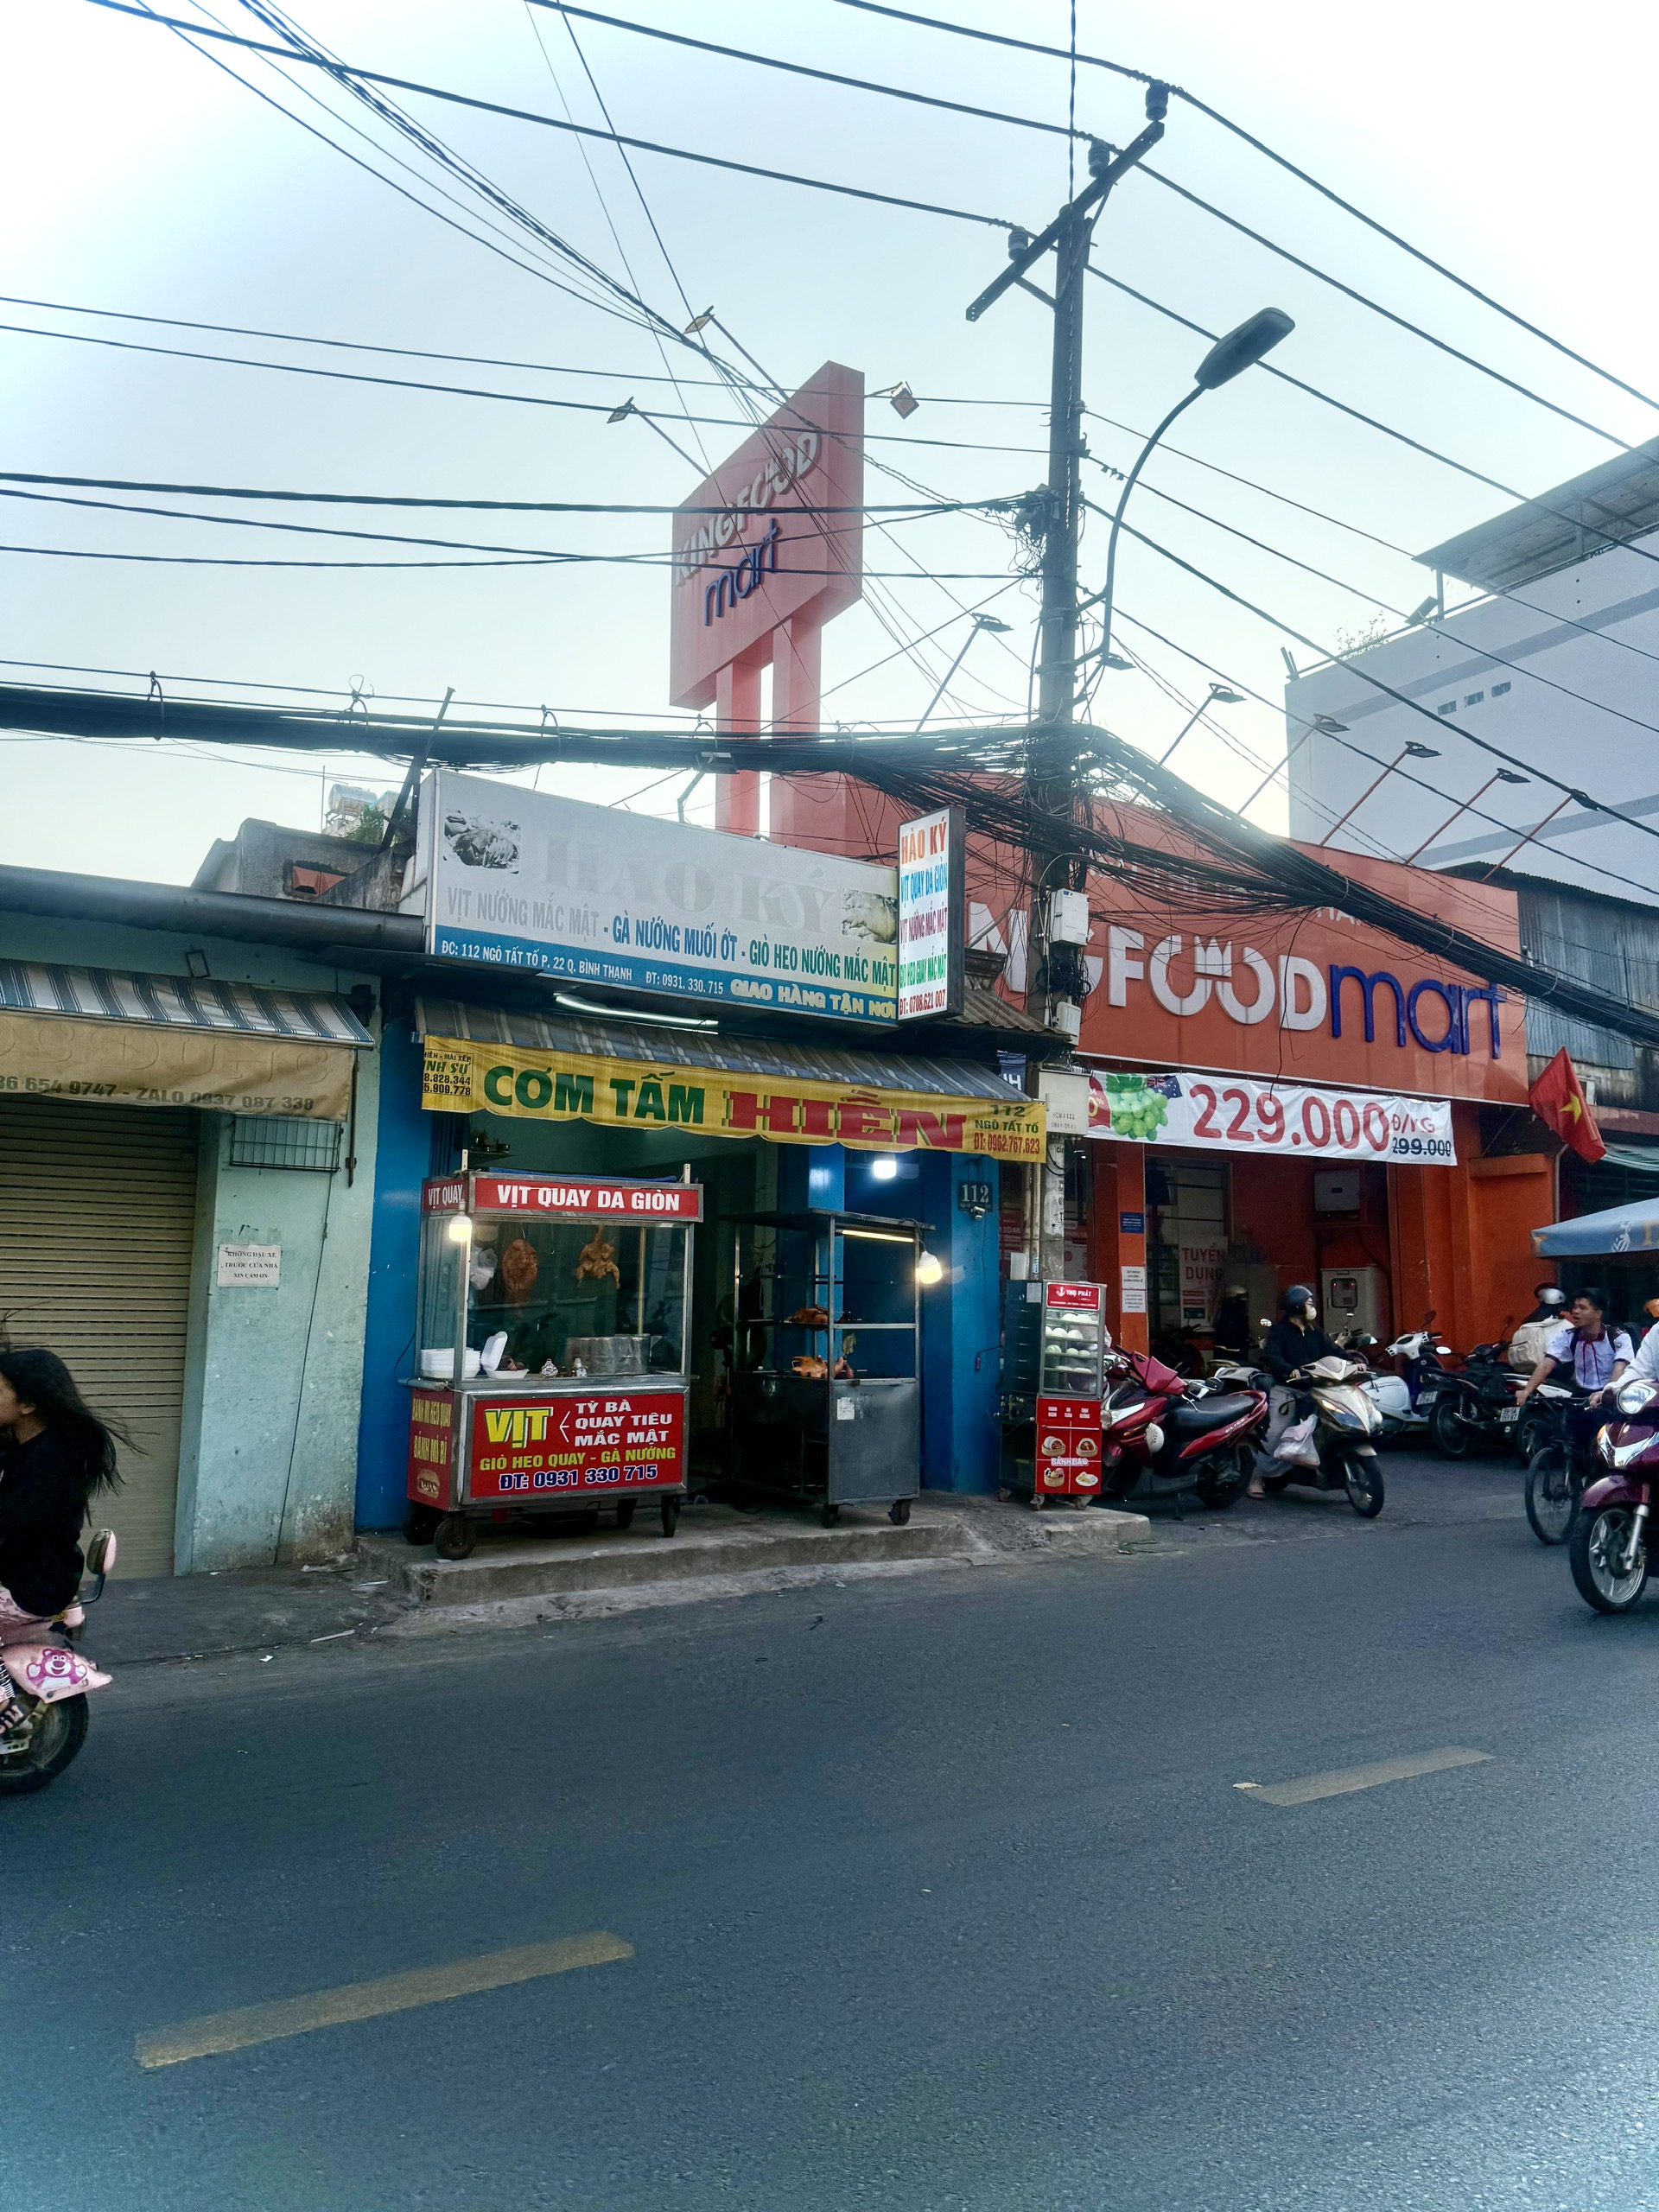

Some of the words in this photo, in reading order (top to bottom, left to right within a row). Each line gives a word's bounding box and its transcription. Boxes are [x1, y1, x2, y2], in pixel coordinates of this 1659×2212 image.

[704, 518, 783, 626] mart
[930, 817, 947, 855] KÝ
[448, 886, 474, 922] VỊT
[477, 887, 529, 928] NƯỚNG
[532, 892, 564, 931] MẮC
[569, 901, 600, 944] MẬT
[612, 910, 630, 944] GÀ
[635, 915, 681, 951] NƯỚNG
[684, 918, 717, 959] MUỐI
[720, 926, 738, 962] ỚT
[749, 932, 769, 968] GIÒ
[773, 944, 798, 973] HEO
[801, 944, 842, 979] NƯỚNG
[843, 946, 869, 983] MẮC
[872, 952, 896, 993] MẬT
[442, 939, 457, 956] ĐC:
[461, 943, 480, 959] 112
[482, 944, 502, 963] NGÔ
[505, 945, 524, 966] TẤT
[526, 947, 539, 967] TỐ
[541, 955, 550, 968] P.
[553, 956, 565, 970] 22
[568, 958, 577, 974] Q.
[579, 957, 601, 976] BÌNH
[602, 963, 632, 981] THẠNH
[645, 969, 659, 985] ĐT:
[662, 971, 686, 989] 0931.
[688, 976, 705, 993] 330.
[707, 978, 724, 995] 715
[729, 978, 773, 1001] GIAO
[778, 982, 825, 1009] HÀNG
[830, 991, 864, 1015] TẬN
[868, 998, 896, 1019] NƠI
[935, 988, 946, 1007] 007
[423, 1060, 448, 1072] NH
[68, 1081, 118, 1097] 9747
[137, 1087, 184, 1104] ZALO
[241, 1094, 274, 1109] 087
[281, 1096, 315, 1110] 338
[484, 1065, 594, 1114] CƠM
[609, 1071, 707, 1124] TẤM
[989, 1103, 1026, 1118] 112
[1189, 1084, 1389, 1152] 229.000
[975, 1119, 1000, 1131] NGÔ
[1001, 1119, 1021, 1132] TẤT
[1025, 1121, 1039, 1134] TỐ
[974, 1133, 986, 1150] ĐT:
[987, 1133, 1041, 1154] 0962.767.623
[1392, 1136, 1452, 1157] 299.000
[428, 1185, 441, 1209] VỊT
[441, 1184, 463, 1205] QUAY
[497, 1184, 531, 1208] VỊT
[537, 1186, 591, 1208] QUAY
[597, 1190, 625, 1209] DA
[632, 1189, 680, 1211] GIÒN
[962, 1183, 989, 1203] 112
[485, 1406, 553, 1449] VỊT
[605, 1398, 632, 1413] BÀ
[575, 1415, 626, 1430] QUAY
[630, 1412, 672, 1426] TIÊU
[575, 1429, 620, 1447] MẮC
[626, 1428, 669, 1446] MẬT
[480, 1453, 507, 1471] GIÒ
[512, 1454, 544, 1469] HEO
[548, 1453, 585, 1468] QUAY
[601, 1448, 621, 1463] GÀ
[625, 1447, 676, 1462] NƯỚNG
[499, 1472, 529, 1491] ĐT:
[533, 1470, 579, 1488] 0931
[586, 1467, 620, 1483] 330
[624, 1464, 658, 1481] 715
